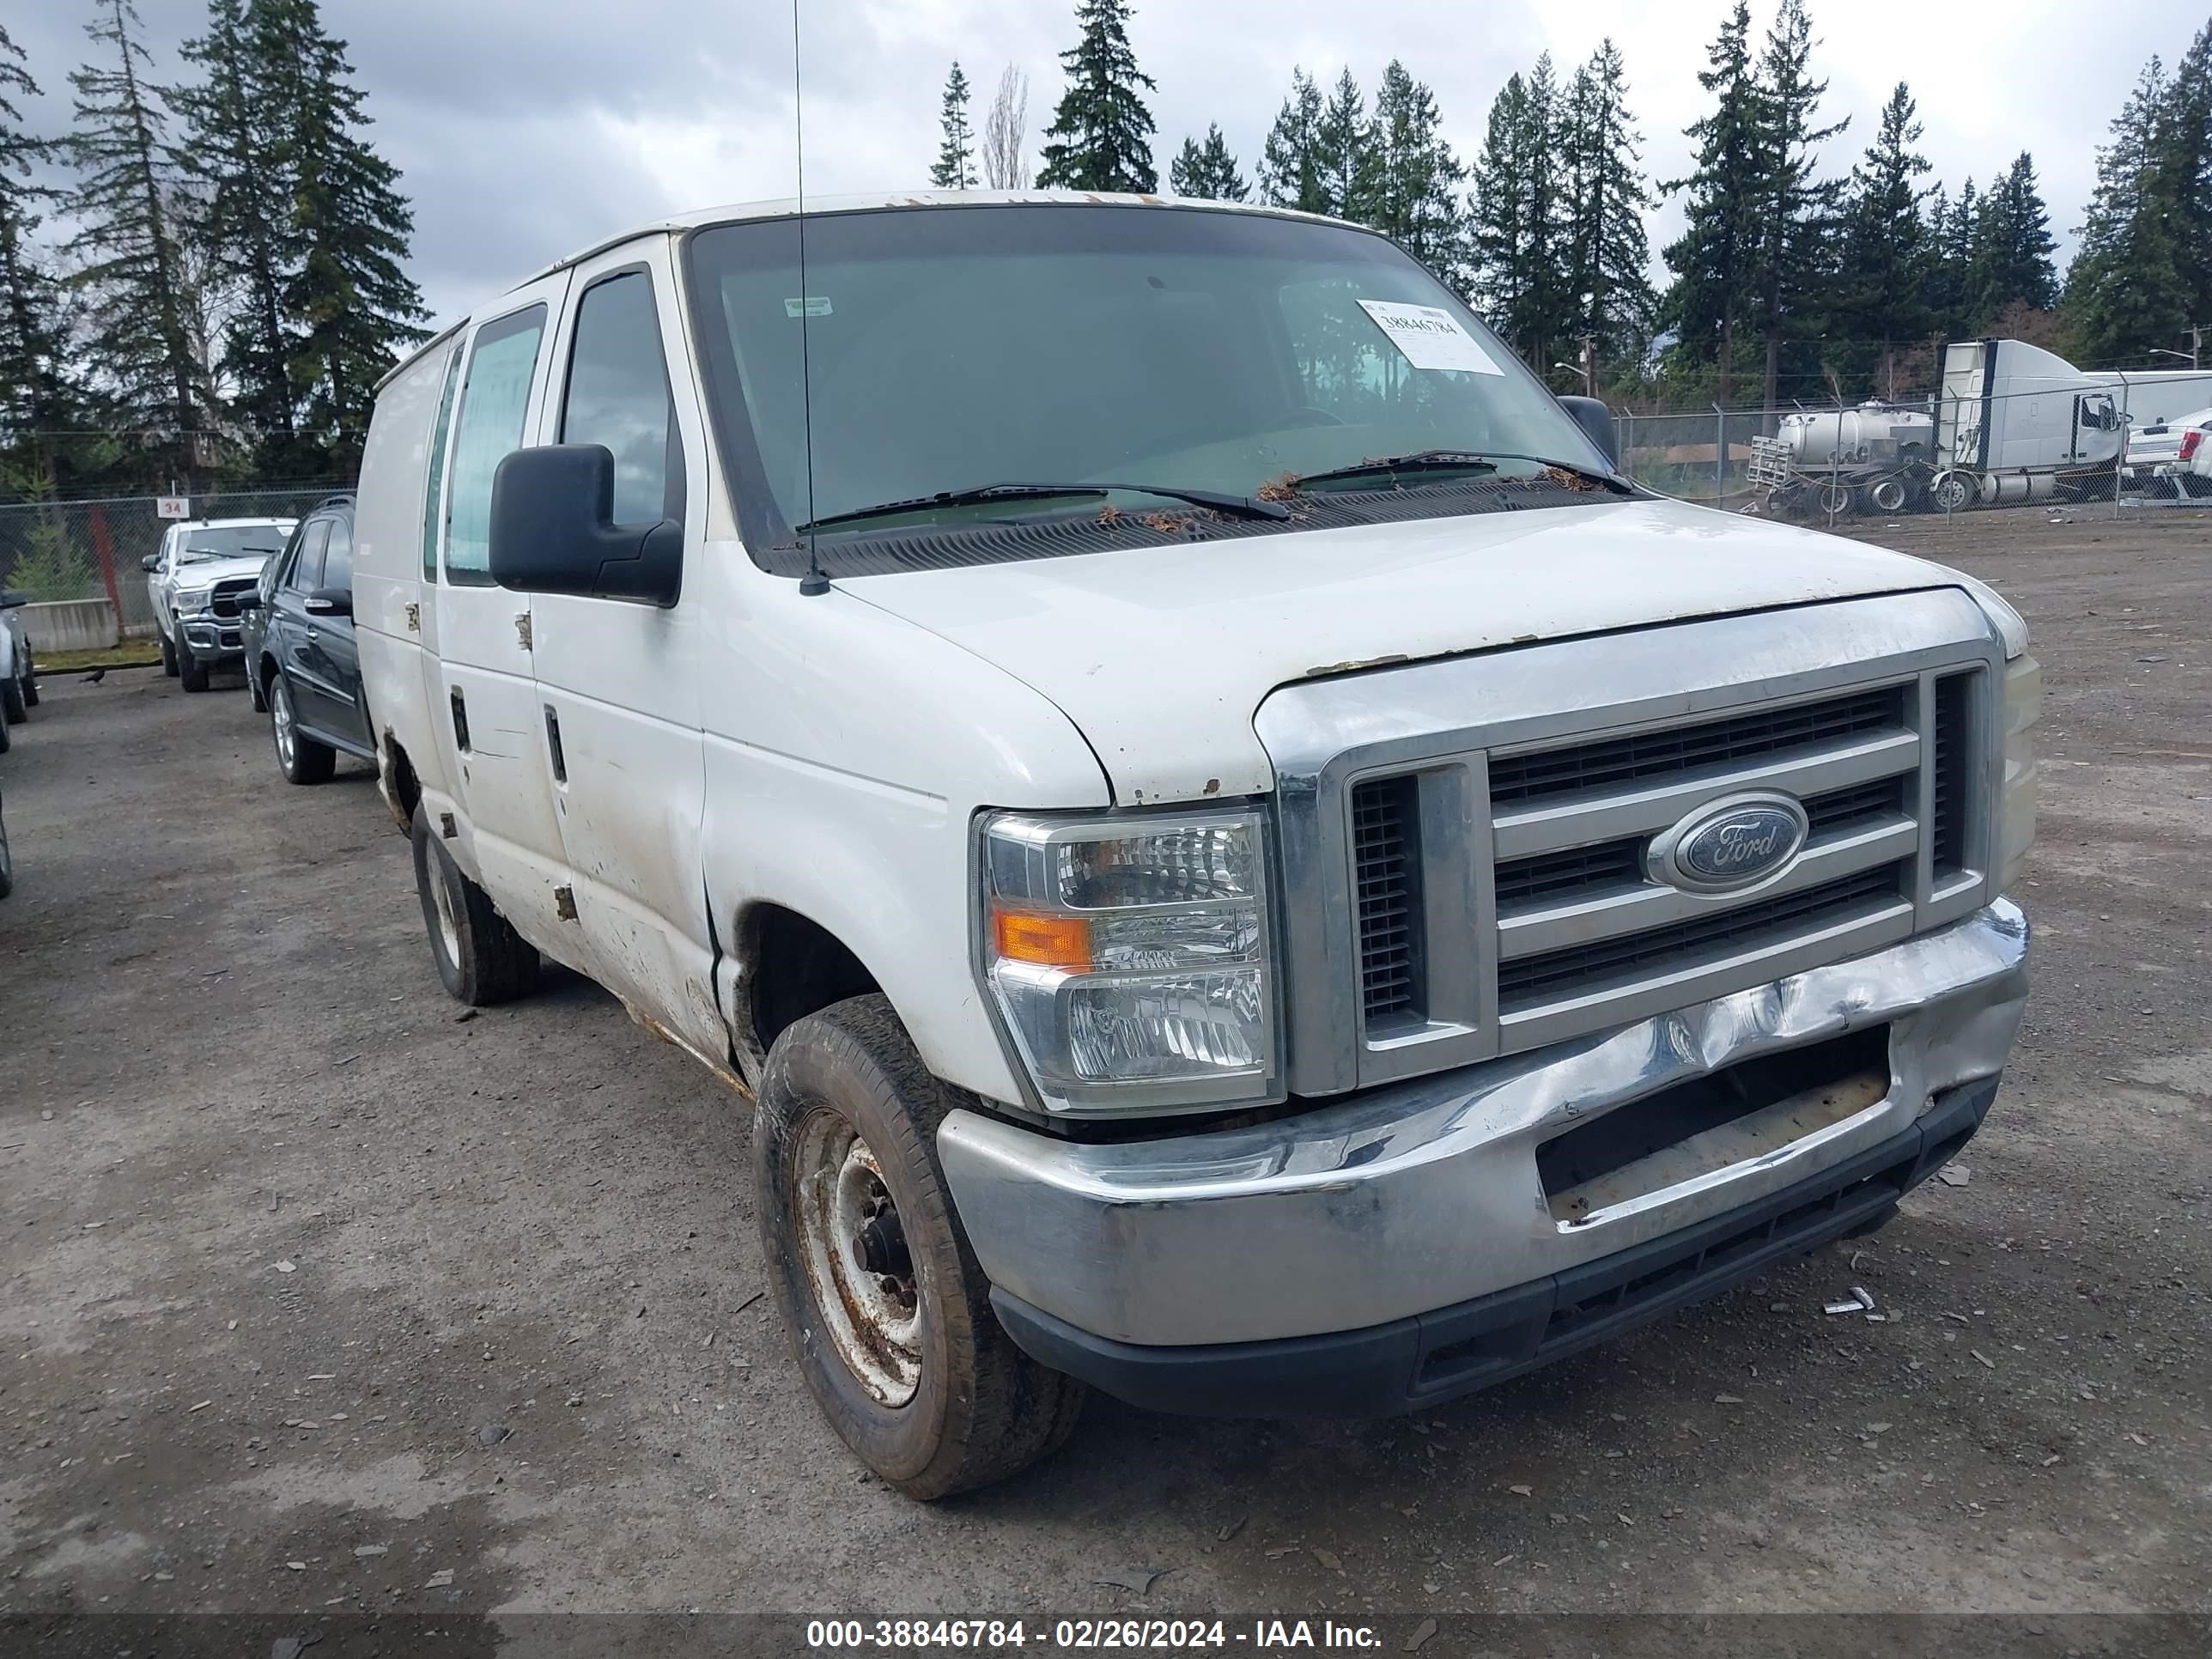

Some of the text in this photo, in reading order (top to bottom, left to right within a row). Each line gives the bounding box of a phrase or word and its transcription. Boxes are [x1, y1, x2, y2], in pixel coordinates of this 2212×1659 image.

[1381, 315, 1458, 336] 38846784
[165, 503, 181, 514] 34
[1714, 821, 1778, 866] Ford
